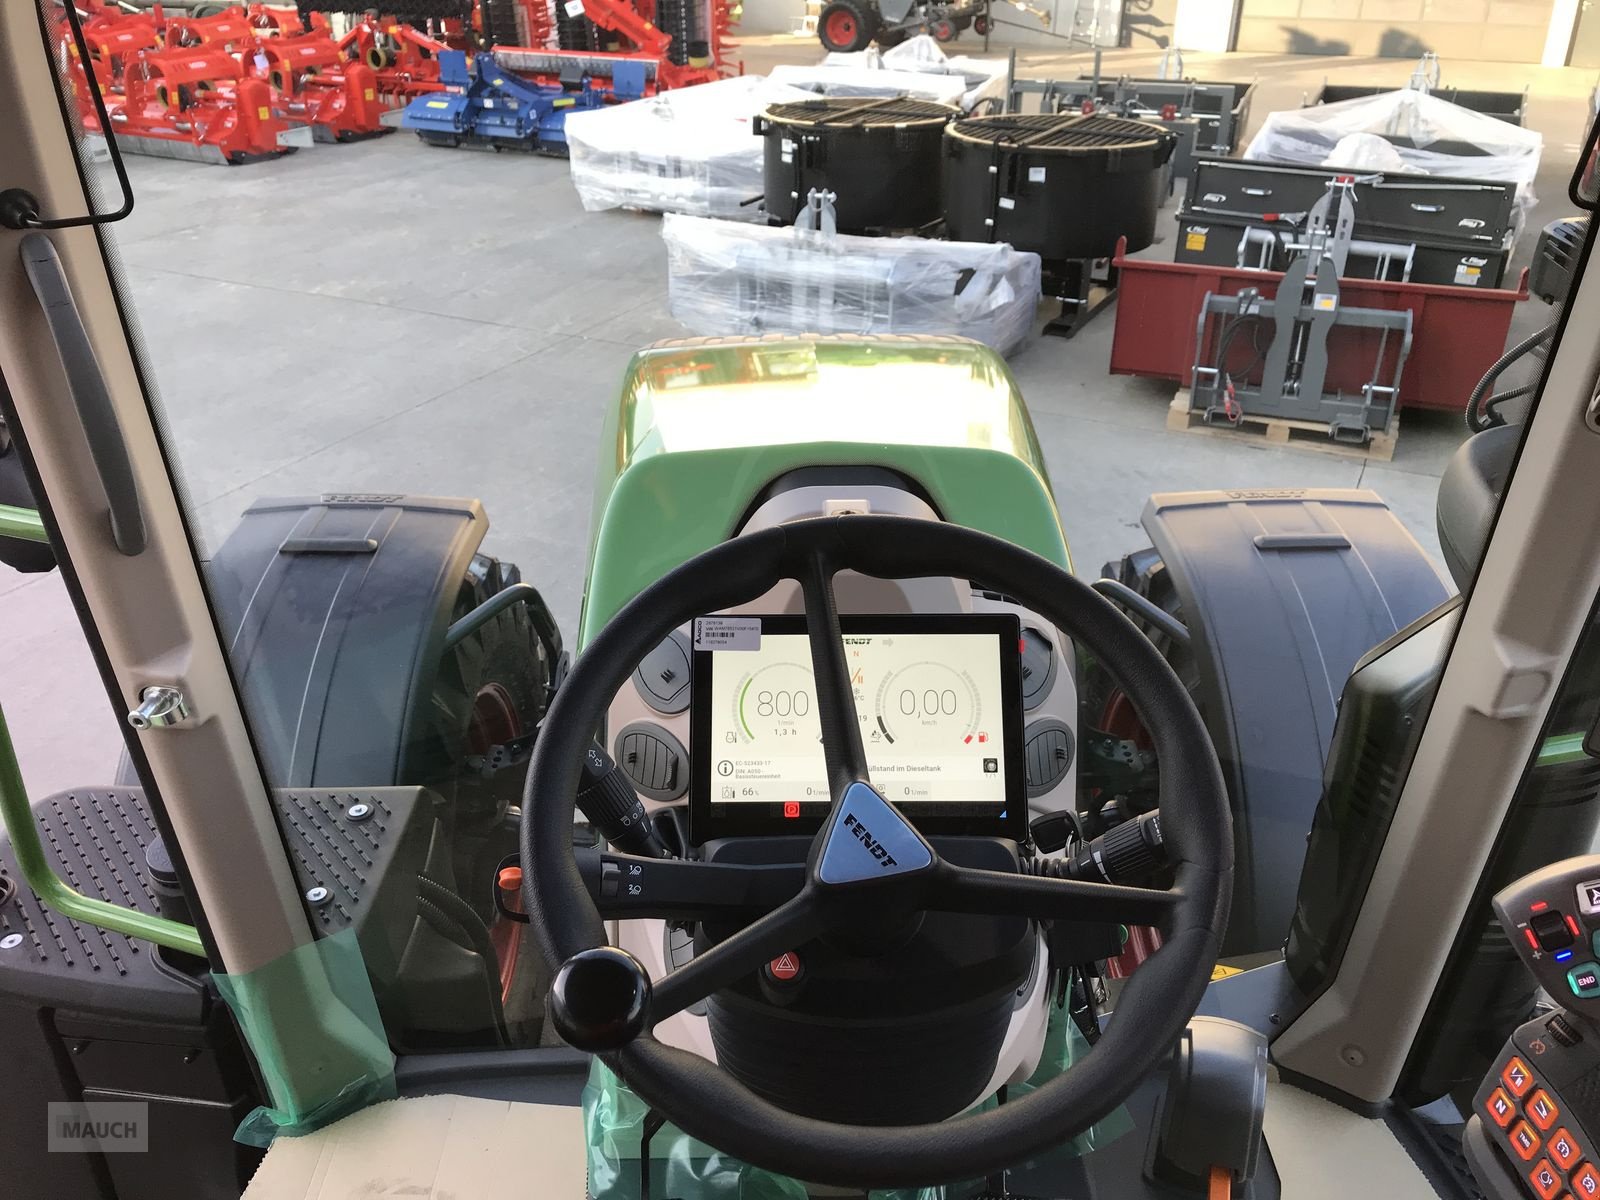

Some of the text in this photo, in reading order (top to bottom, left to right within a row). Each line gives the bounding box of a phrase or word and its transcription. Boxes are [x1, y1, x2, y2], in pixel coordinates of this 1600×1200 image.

[757, 690, 809, 717] 800
[900, 689, 957, 719] 0,00
[774, 728, 797, 737] 1,3 h
[867, 762, 942, 772] üllstand im Dieseltank
[742, 787, 754, 796] 66
[806, 786, 813, 796] 0
[904, 786, 910, 796] 0
[843, 813, 898, 867] FENDT
[1578, 976, 1595, 986] END
[1495, 1099, 1507, 1114] N
